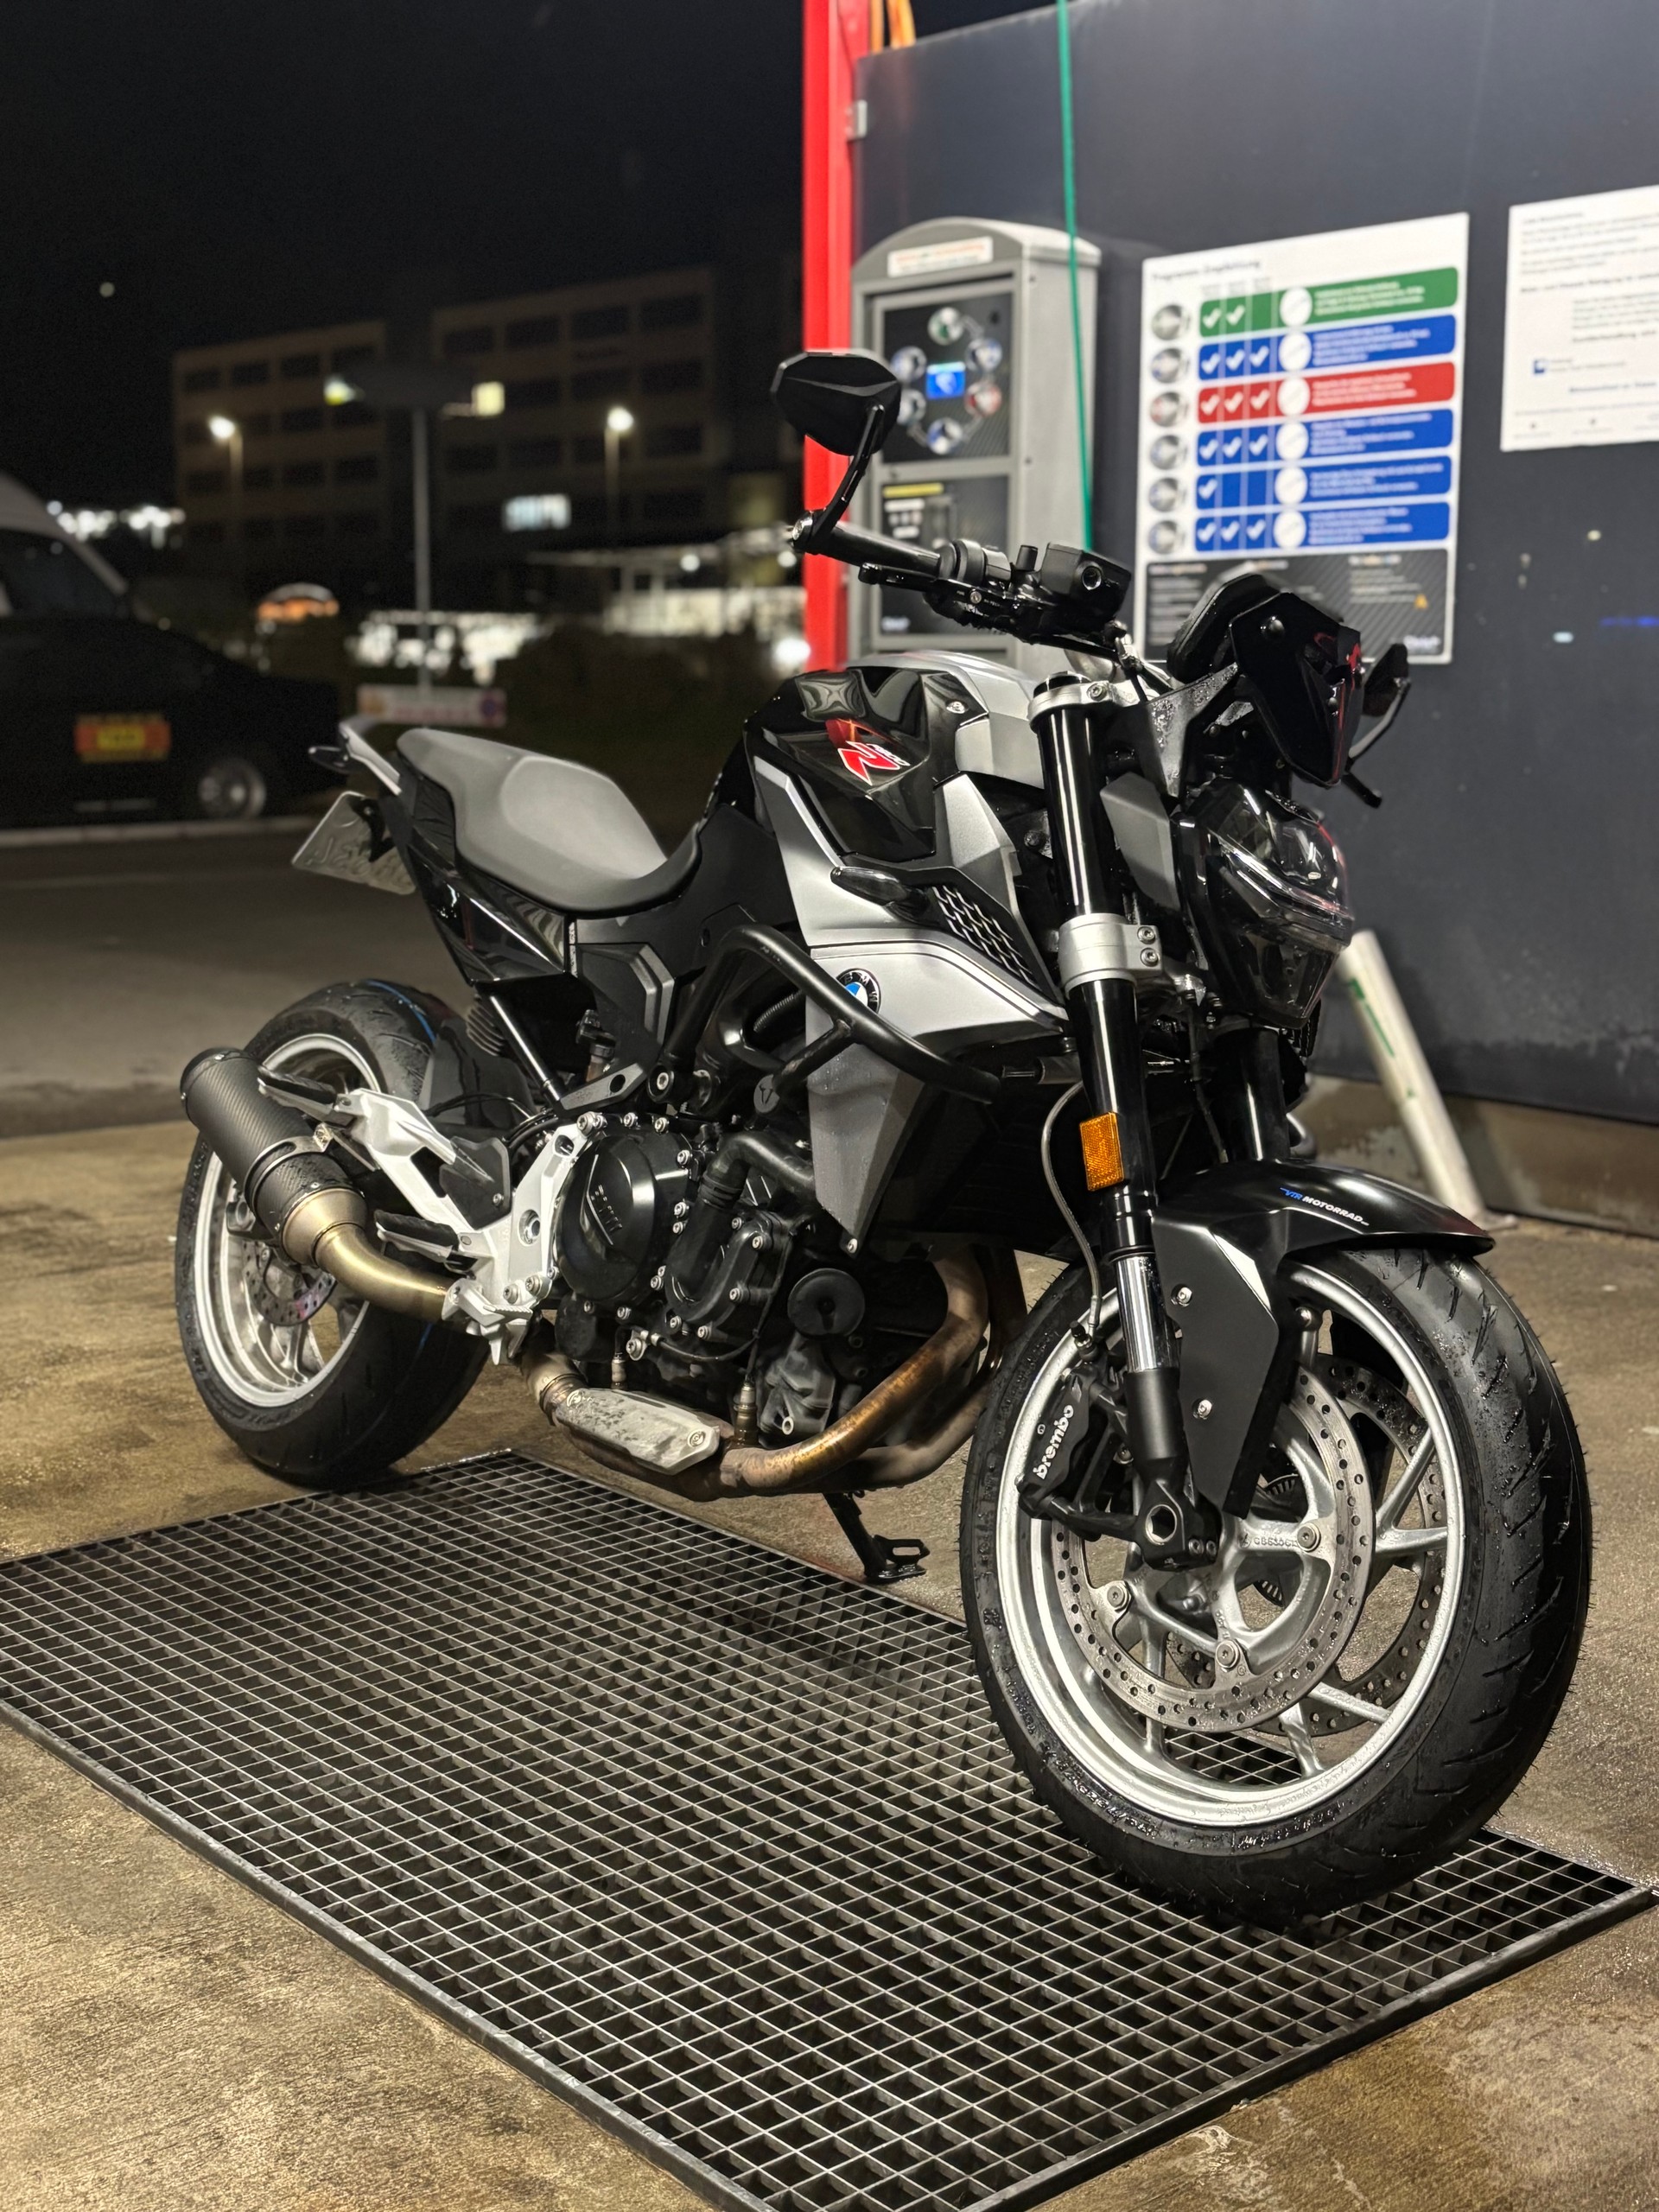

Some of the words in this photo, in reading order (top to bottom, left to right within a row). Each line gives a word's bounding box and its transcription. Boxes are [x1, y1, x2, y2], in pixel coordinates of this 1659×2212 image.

[844, 971, 878, 1002] BMW
[1302, 1196, 1363, 1223] MOTORRAD
[1033, 1404, 1074, 1480] brembo
